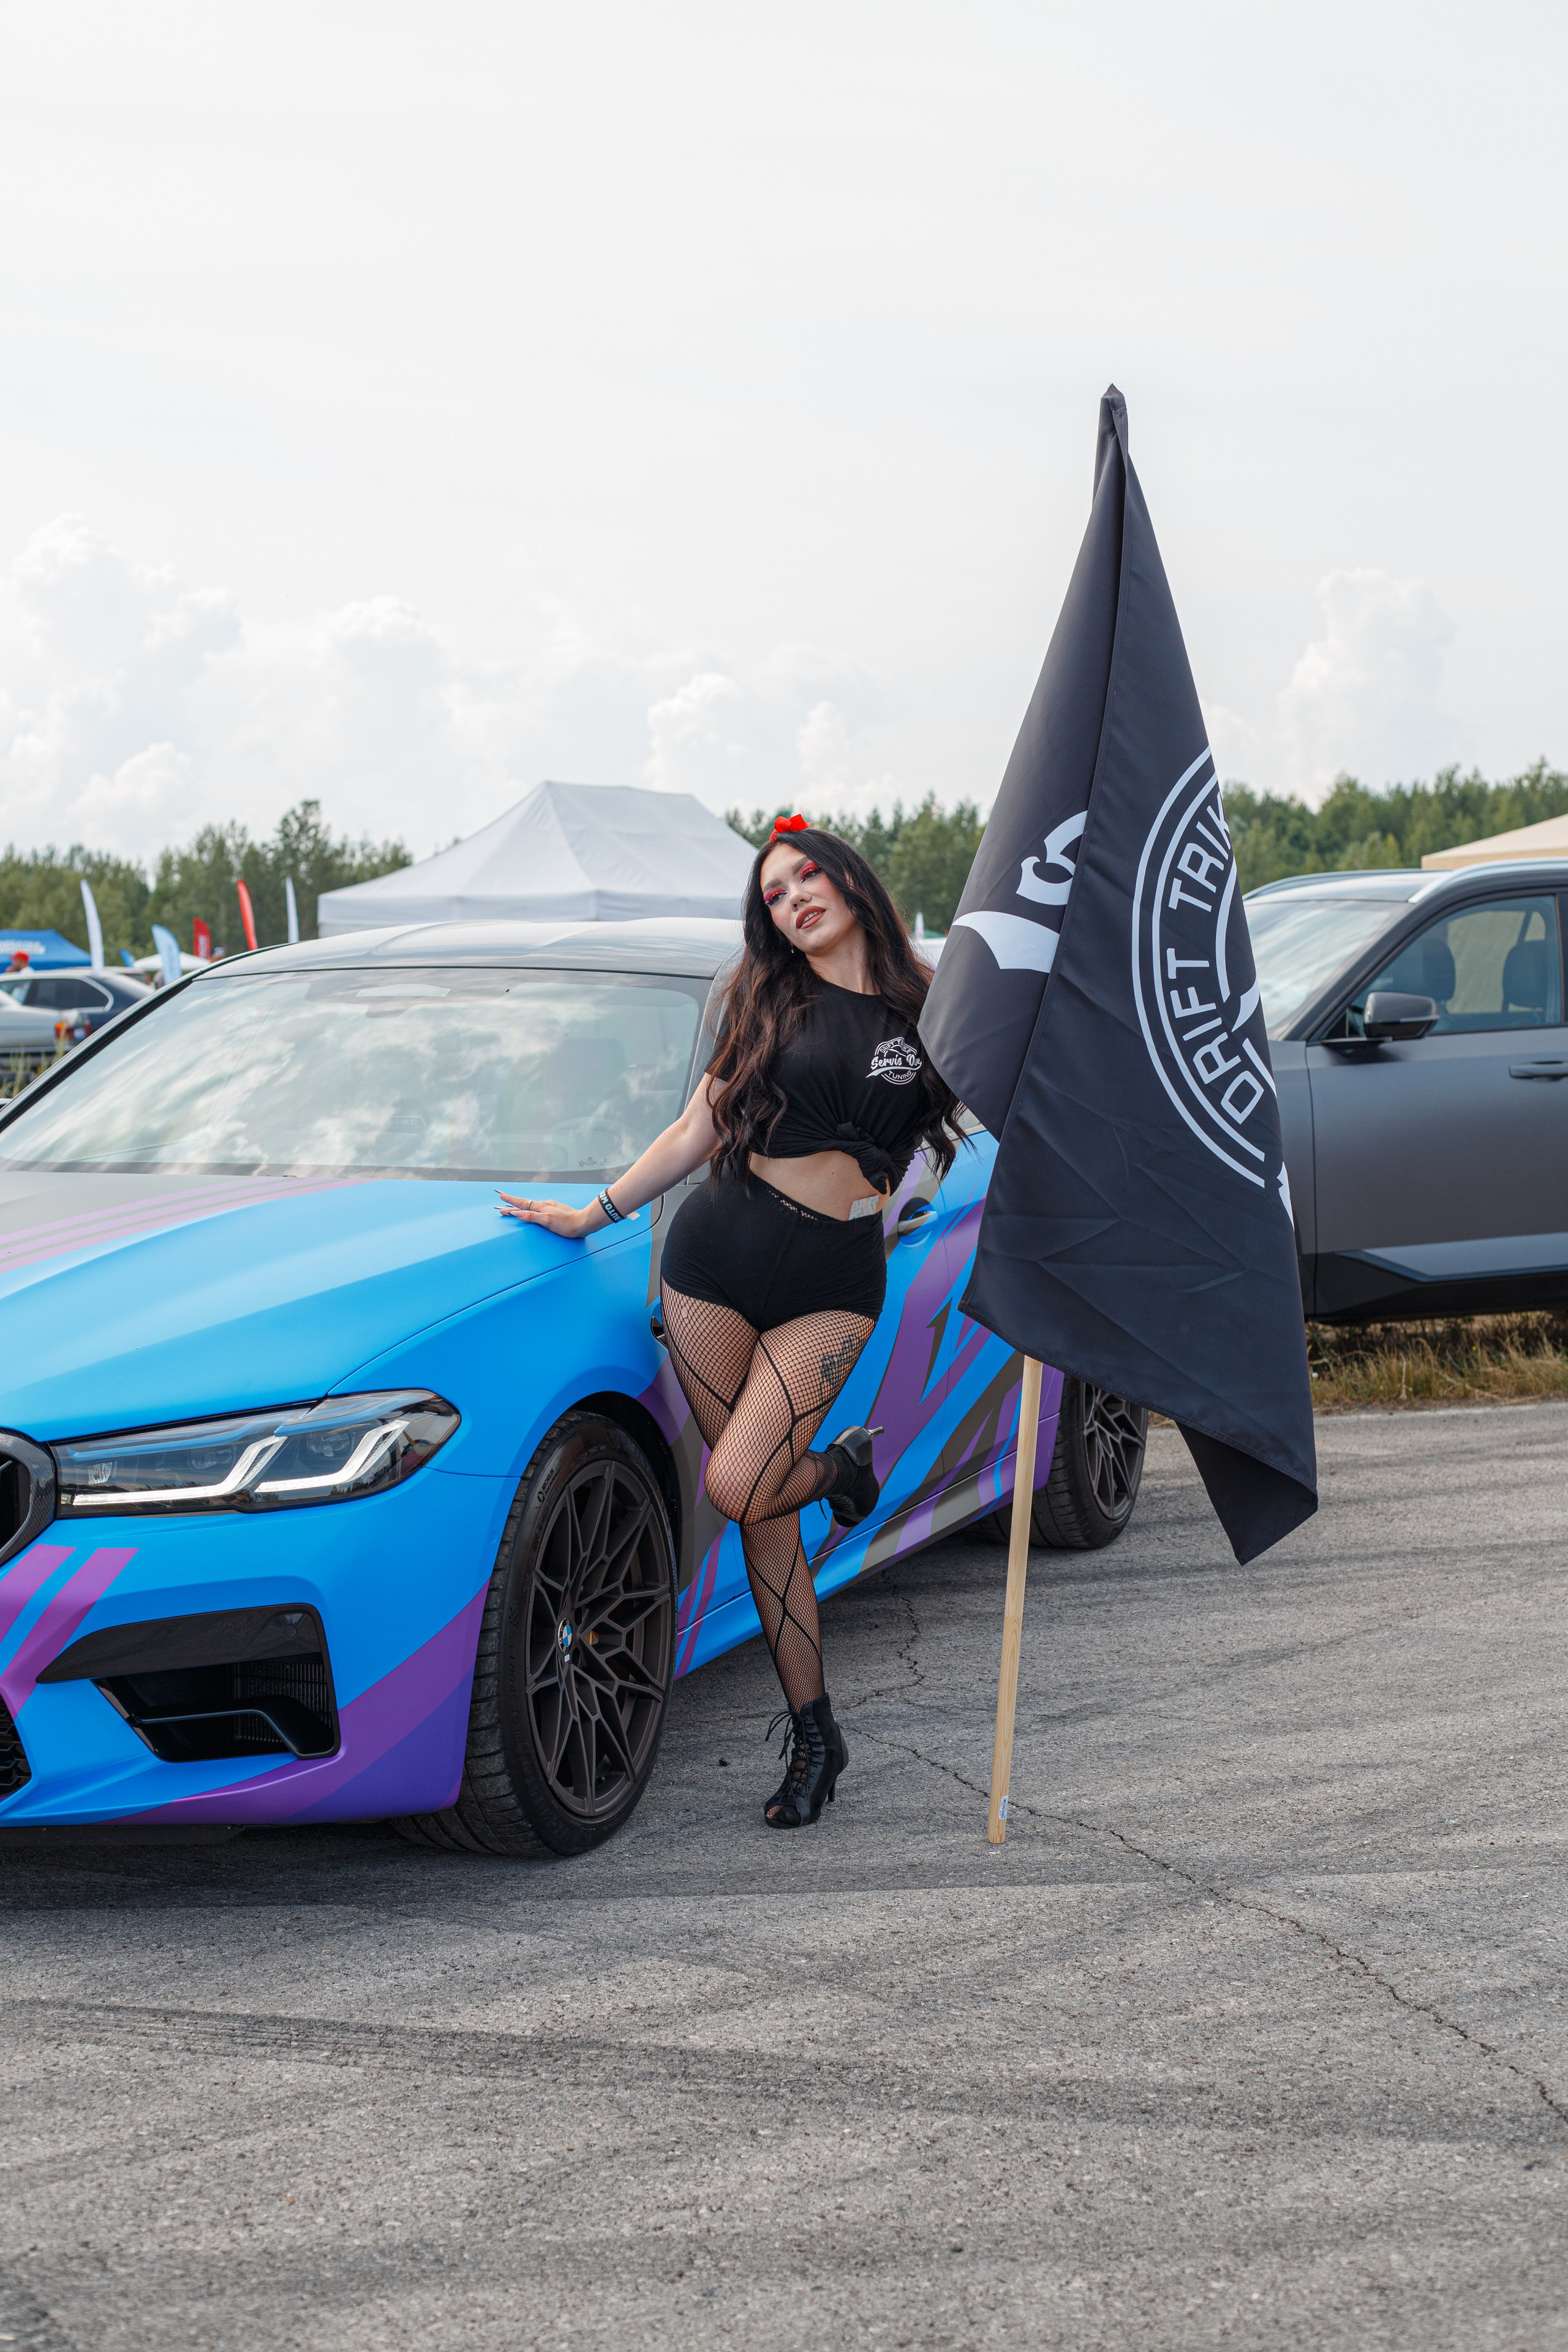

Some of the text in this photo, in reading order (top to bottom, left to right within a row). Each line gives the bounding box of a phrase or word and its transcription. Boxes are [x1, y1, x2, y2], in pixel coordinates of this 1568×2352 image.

[1167, 947, 1264, 1125] DRIFT
[879, 1042, 894, 1054] DRIFT
[871, 1055, 902, 1070] Servis
[888, 1070, 912, 1080] TUNING
[605, 1204, 621, 1221] AUTO
[541, 1468, 554, 1491] MICHELIN
